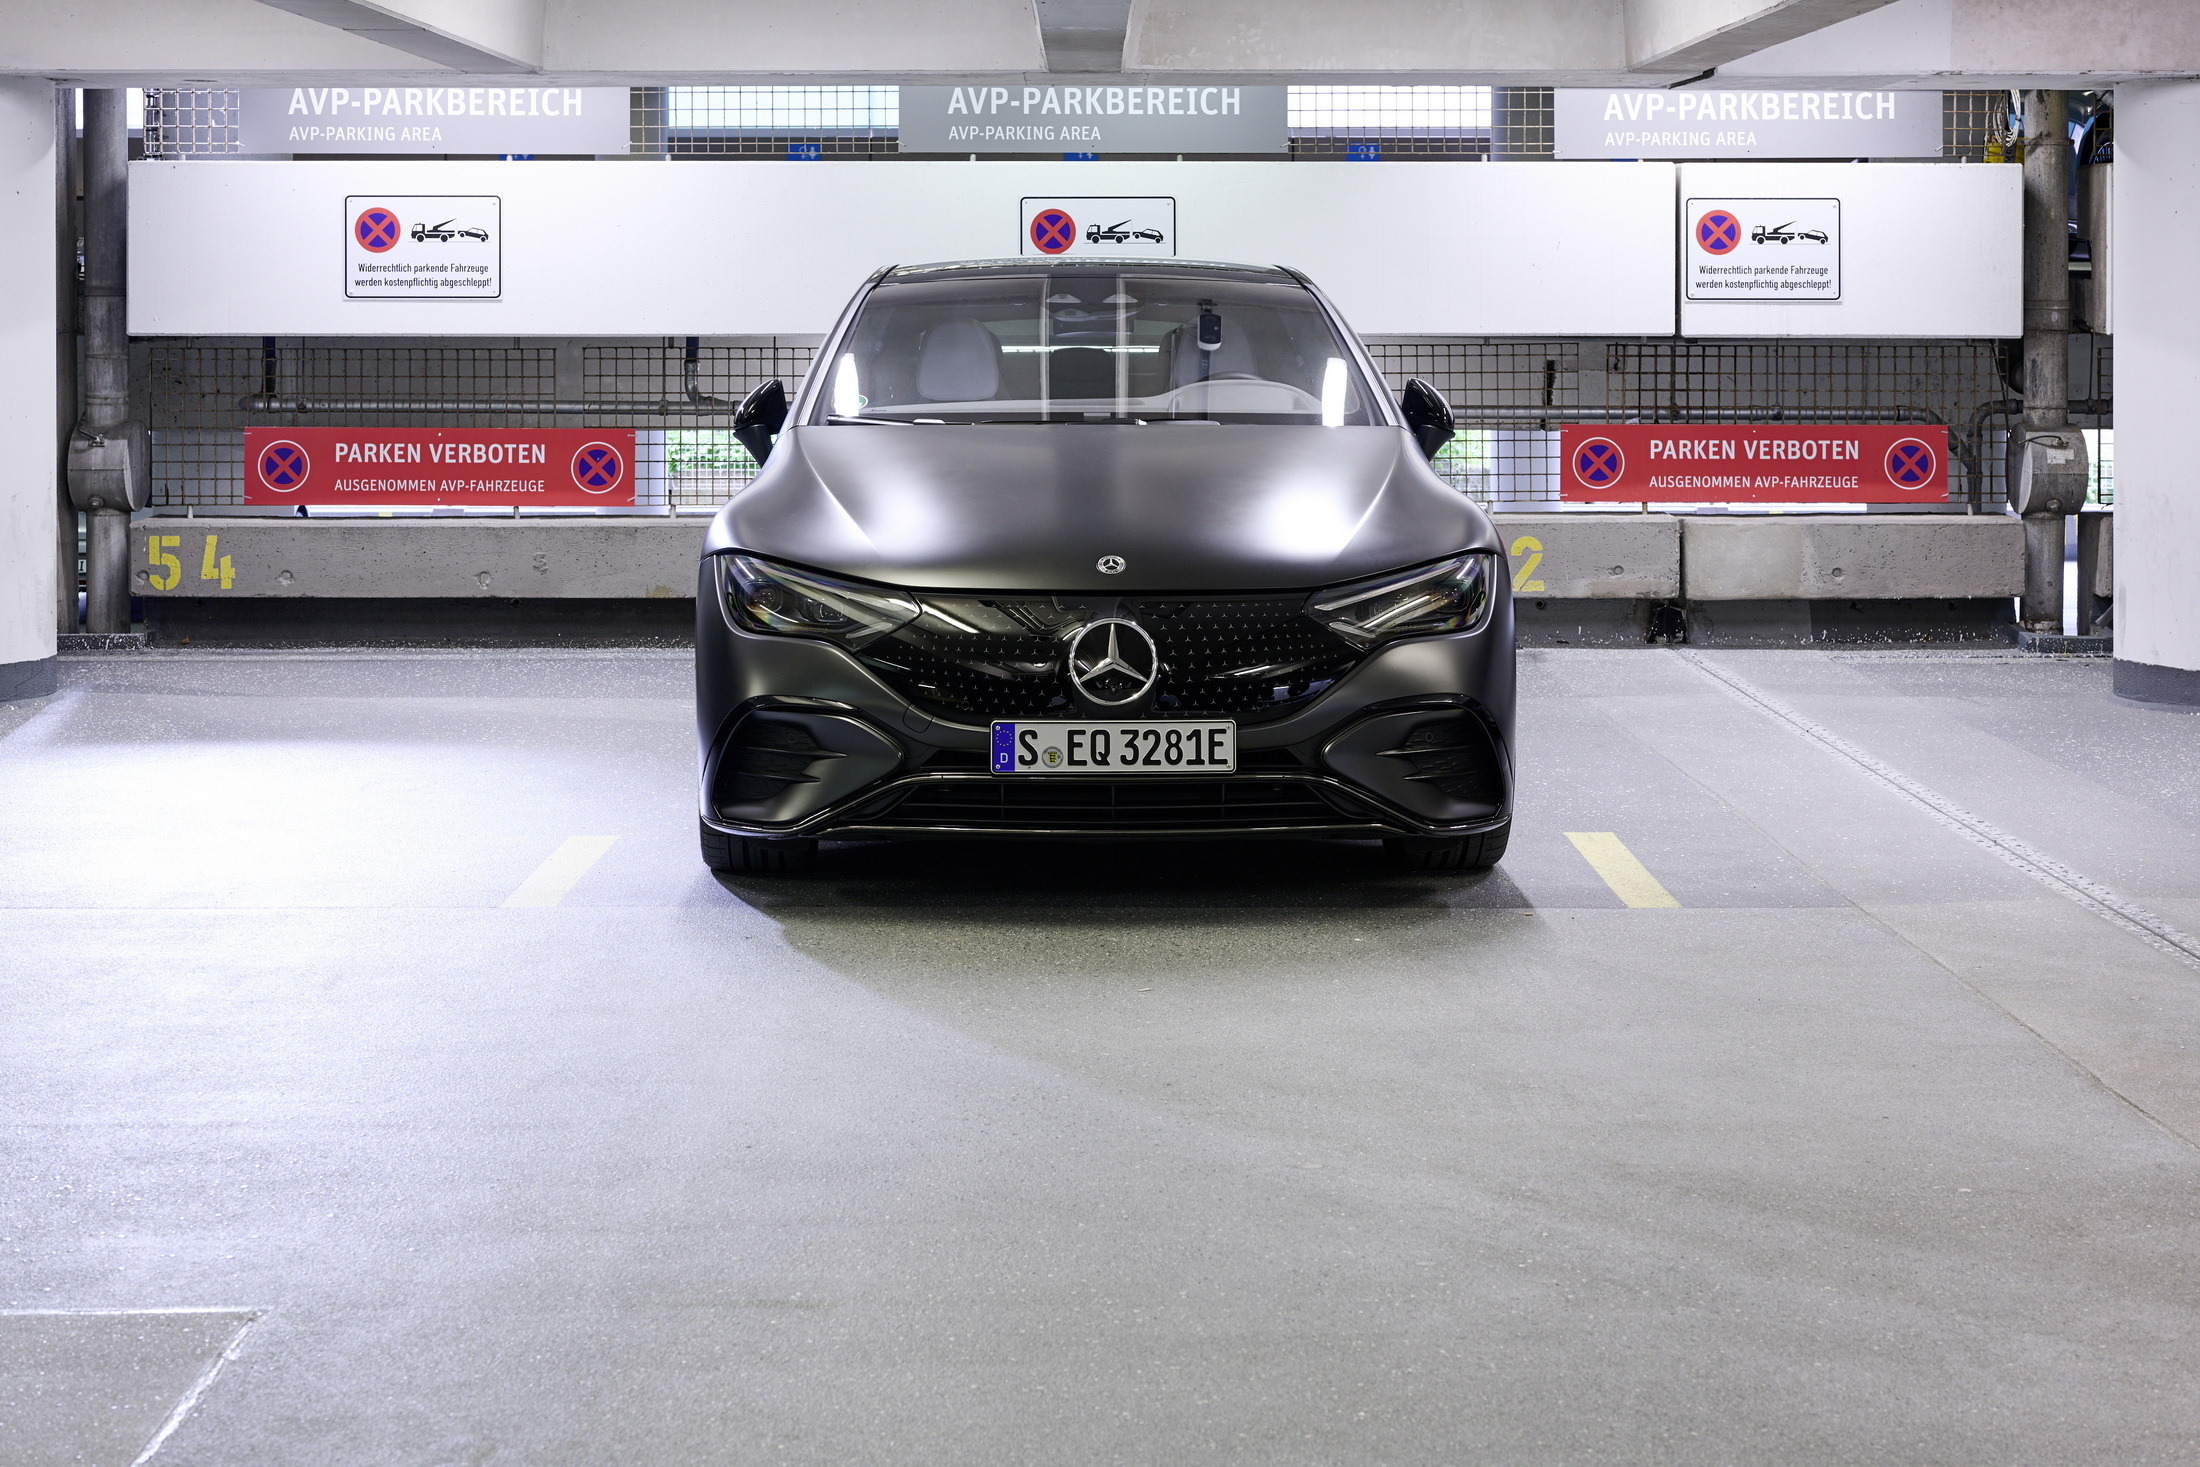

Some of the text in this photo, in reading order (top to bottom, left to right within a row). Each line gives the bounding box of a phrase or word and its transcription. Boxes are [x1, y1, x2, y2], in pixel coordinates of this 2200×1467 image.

[288, 87, 582, 117] AVP-PARKBEREICH
[947, 87, 1241, 116] AVP-PARKBEREICH
[1603, 92, 1896, 121] AVP-PARKBEREICH
[289, 126, 442, 141] AVP-PARKING AREA
[948, 126, 1101, 141] AVP-PARKING AREA
[1604, 131, 1757, 147] AVP-PARKING AREA
[358, 263, 489, 275] Widerrechtlich parkende Fahrzeuge
[1698, 265, 1829, 277] Widerrechtlich parkende Fahrzeuge
[354, 277, 492, 289] werden kostenpflichtig abgeschleppt!
[1695, 279, 1832, 291] werden kostenpflichtig abgeschleppt!
[335, 443, 546, 464] PARKEN VERBOTEN
[1650, 439, 1859, 460] PARKEN VERBOTEN
[334, 478, 545, 492] AUSGENOMMEN AVP-FAHRZEUGE
[1649, 475, 1859, 489] AUSGENOMMEN AVP-FAHRZEUGE
[1000, 752, 1009, 764] D
[1018, 729, 1038, 767] S
[1067, 729, 1111, 767] EQ
[1120, 728, 1229, 767] 3281E
